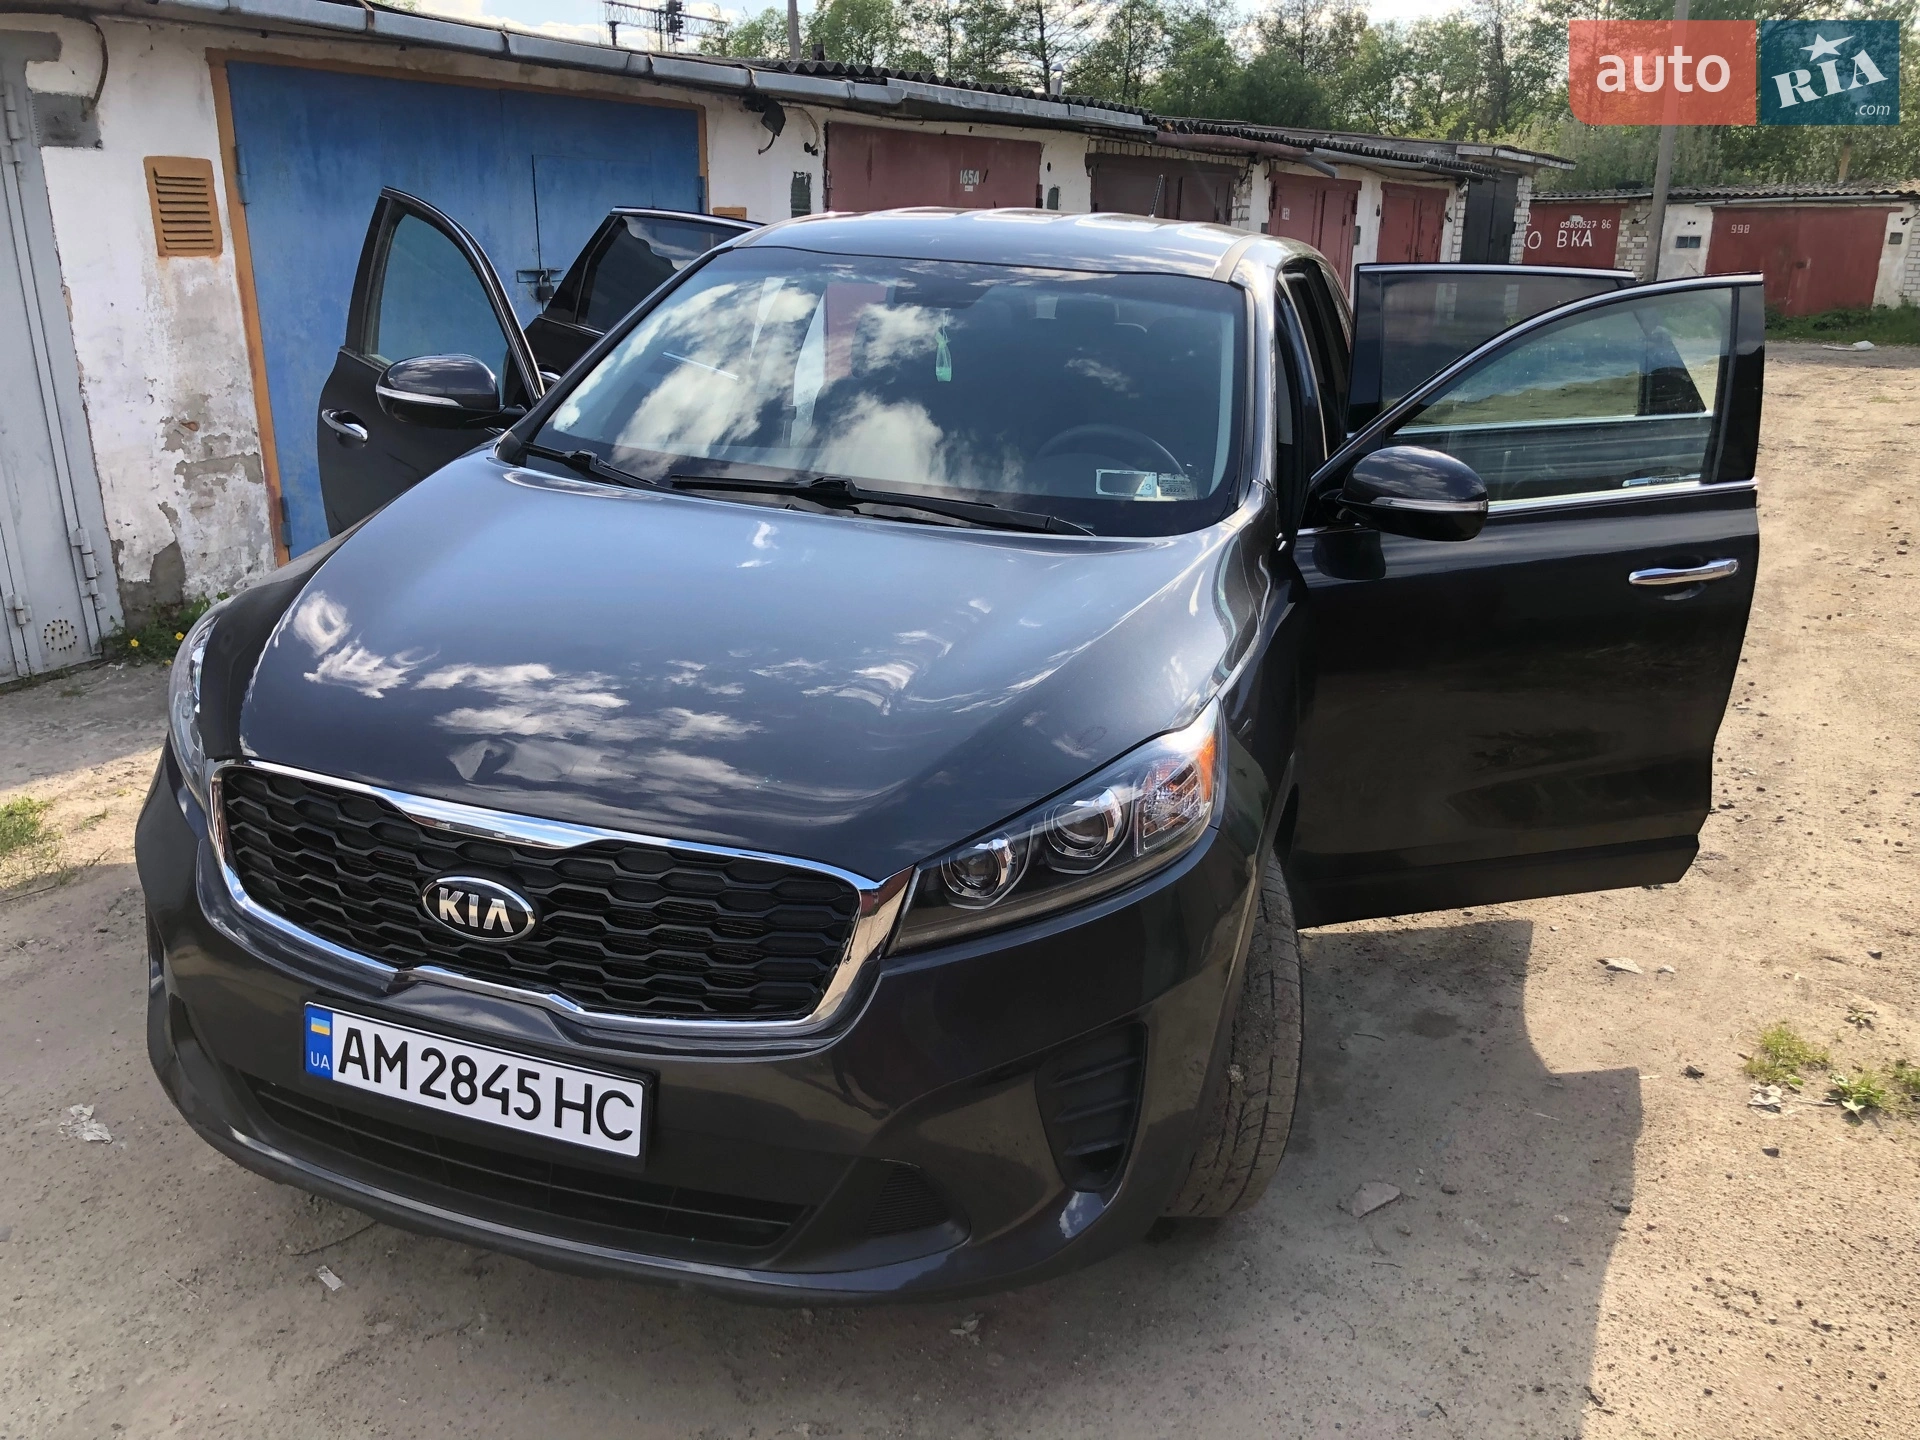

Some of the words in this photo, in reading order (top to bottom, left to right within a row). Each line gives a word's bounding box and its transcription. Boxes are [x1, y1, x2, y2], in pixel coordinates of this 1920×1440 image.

[960, 169, 980, 185] 1654
[1601, 219, 1612, 229] 86
[1731, 224, 1750, 234] 998
[1556, 229, 1593, 248] ВКА
[438, 886, 514, 933] KIA
[310, 1051, 331, 1071] UA
[338, 1027, 408, 1090] AM
[419, 1047, 541, 1121] 2845
[554, 1077, 635, 1141] HC
